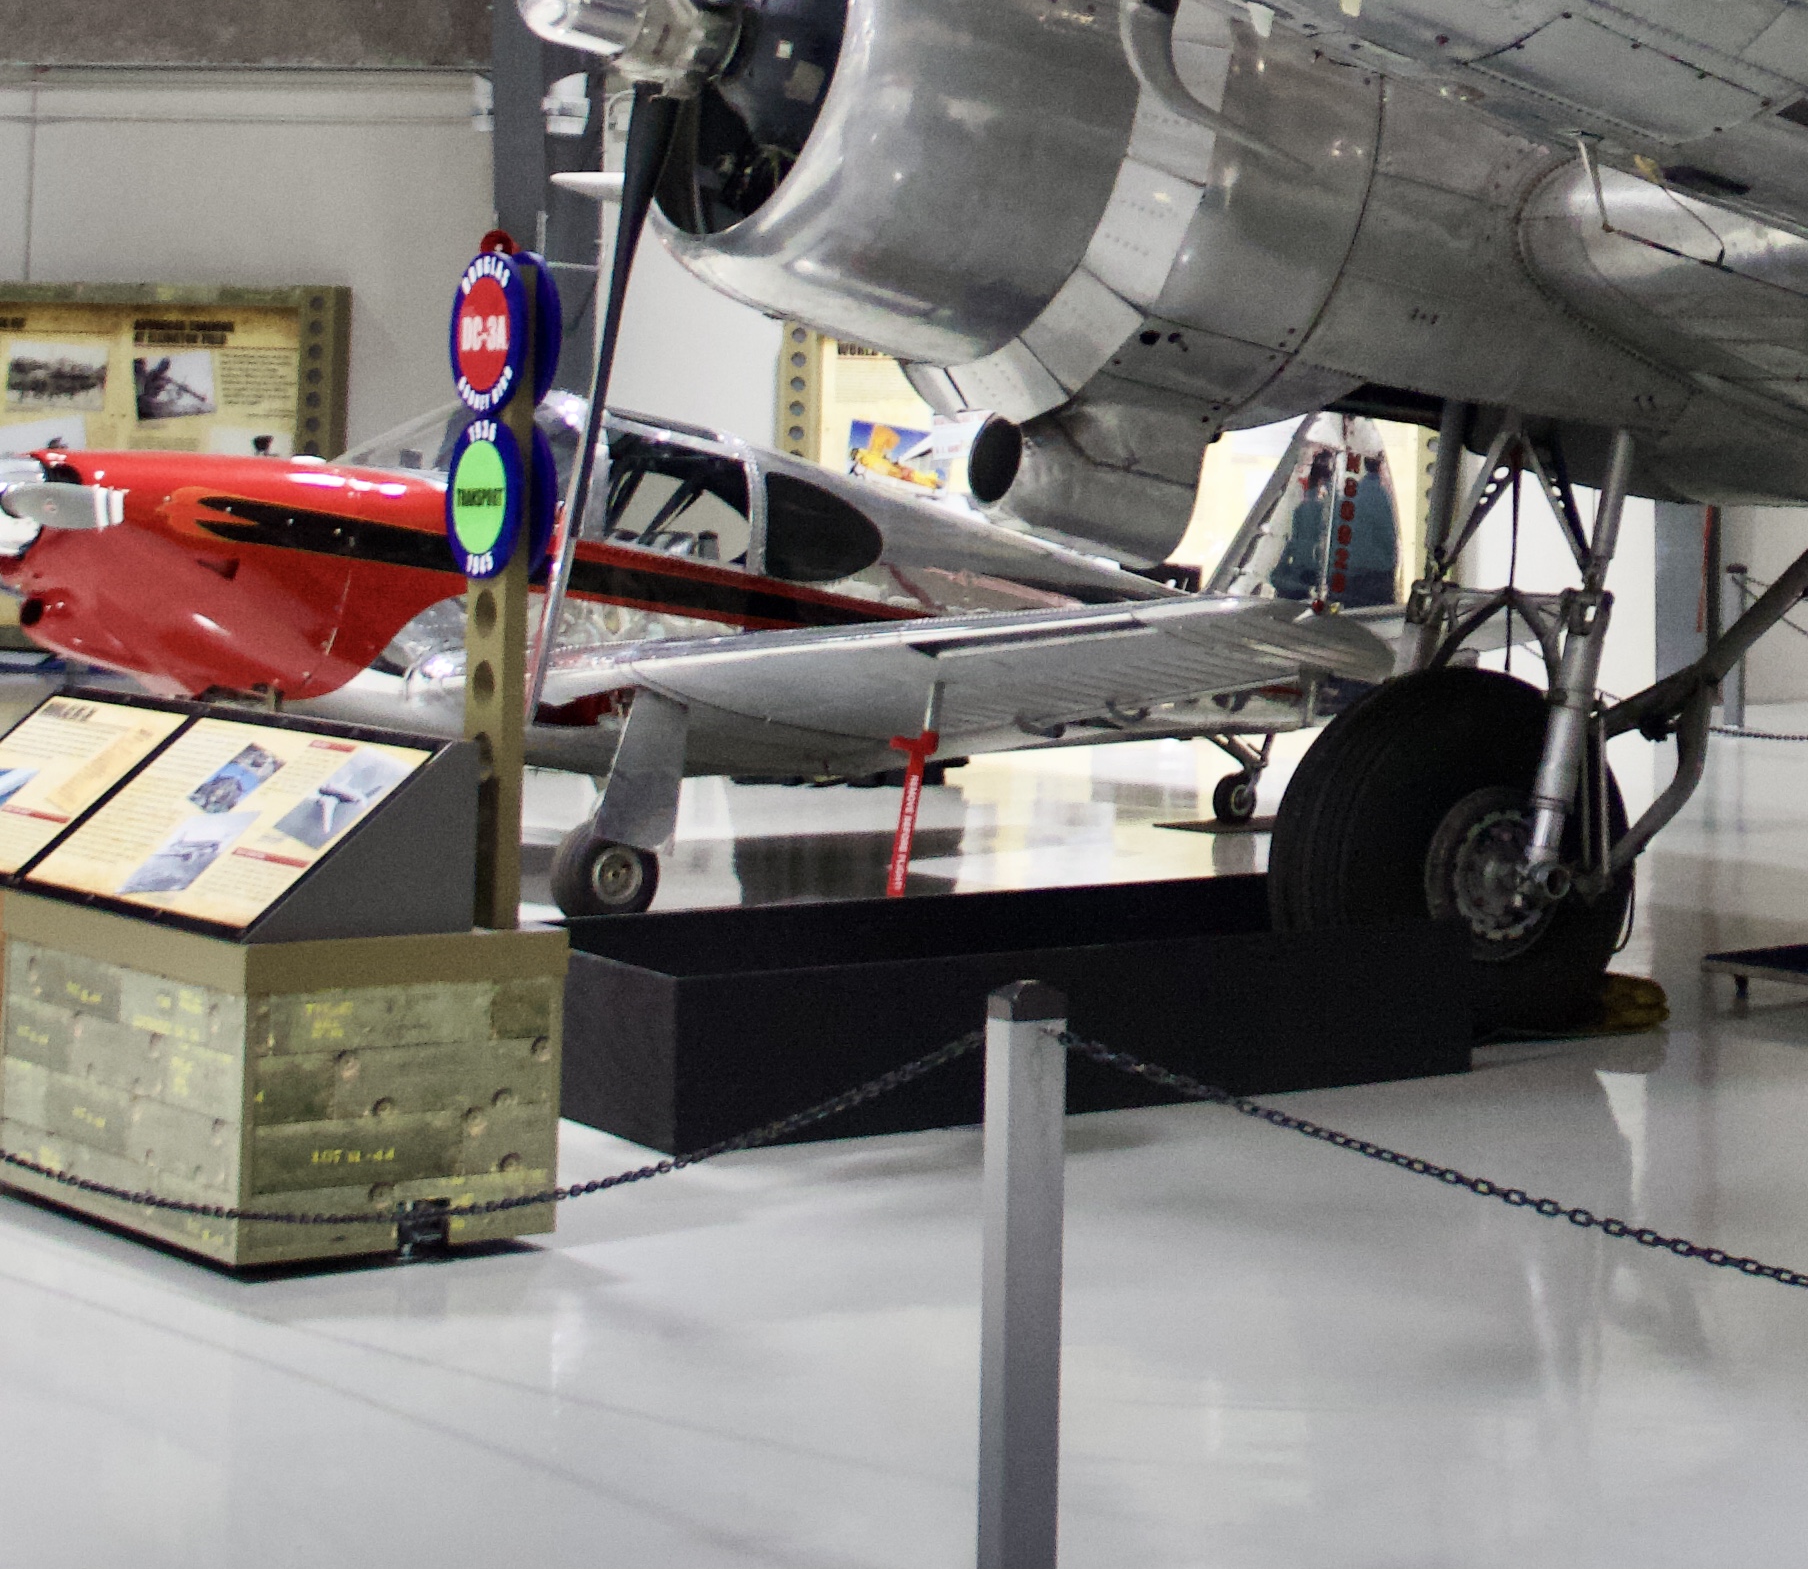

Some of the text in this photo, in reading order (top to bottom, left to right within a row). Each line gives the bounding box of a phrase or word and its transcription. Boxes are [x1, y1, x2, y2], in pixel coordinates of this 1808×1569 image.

[461, 255, 511, 295] DOUGLAS
[461, 315, 509, 352] DC-3A
[456, 487, 504, 508] TRANSPORT
[904, 774, 920, 814] REMOVE
[898, 814, 913, 853] BEFORE
